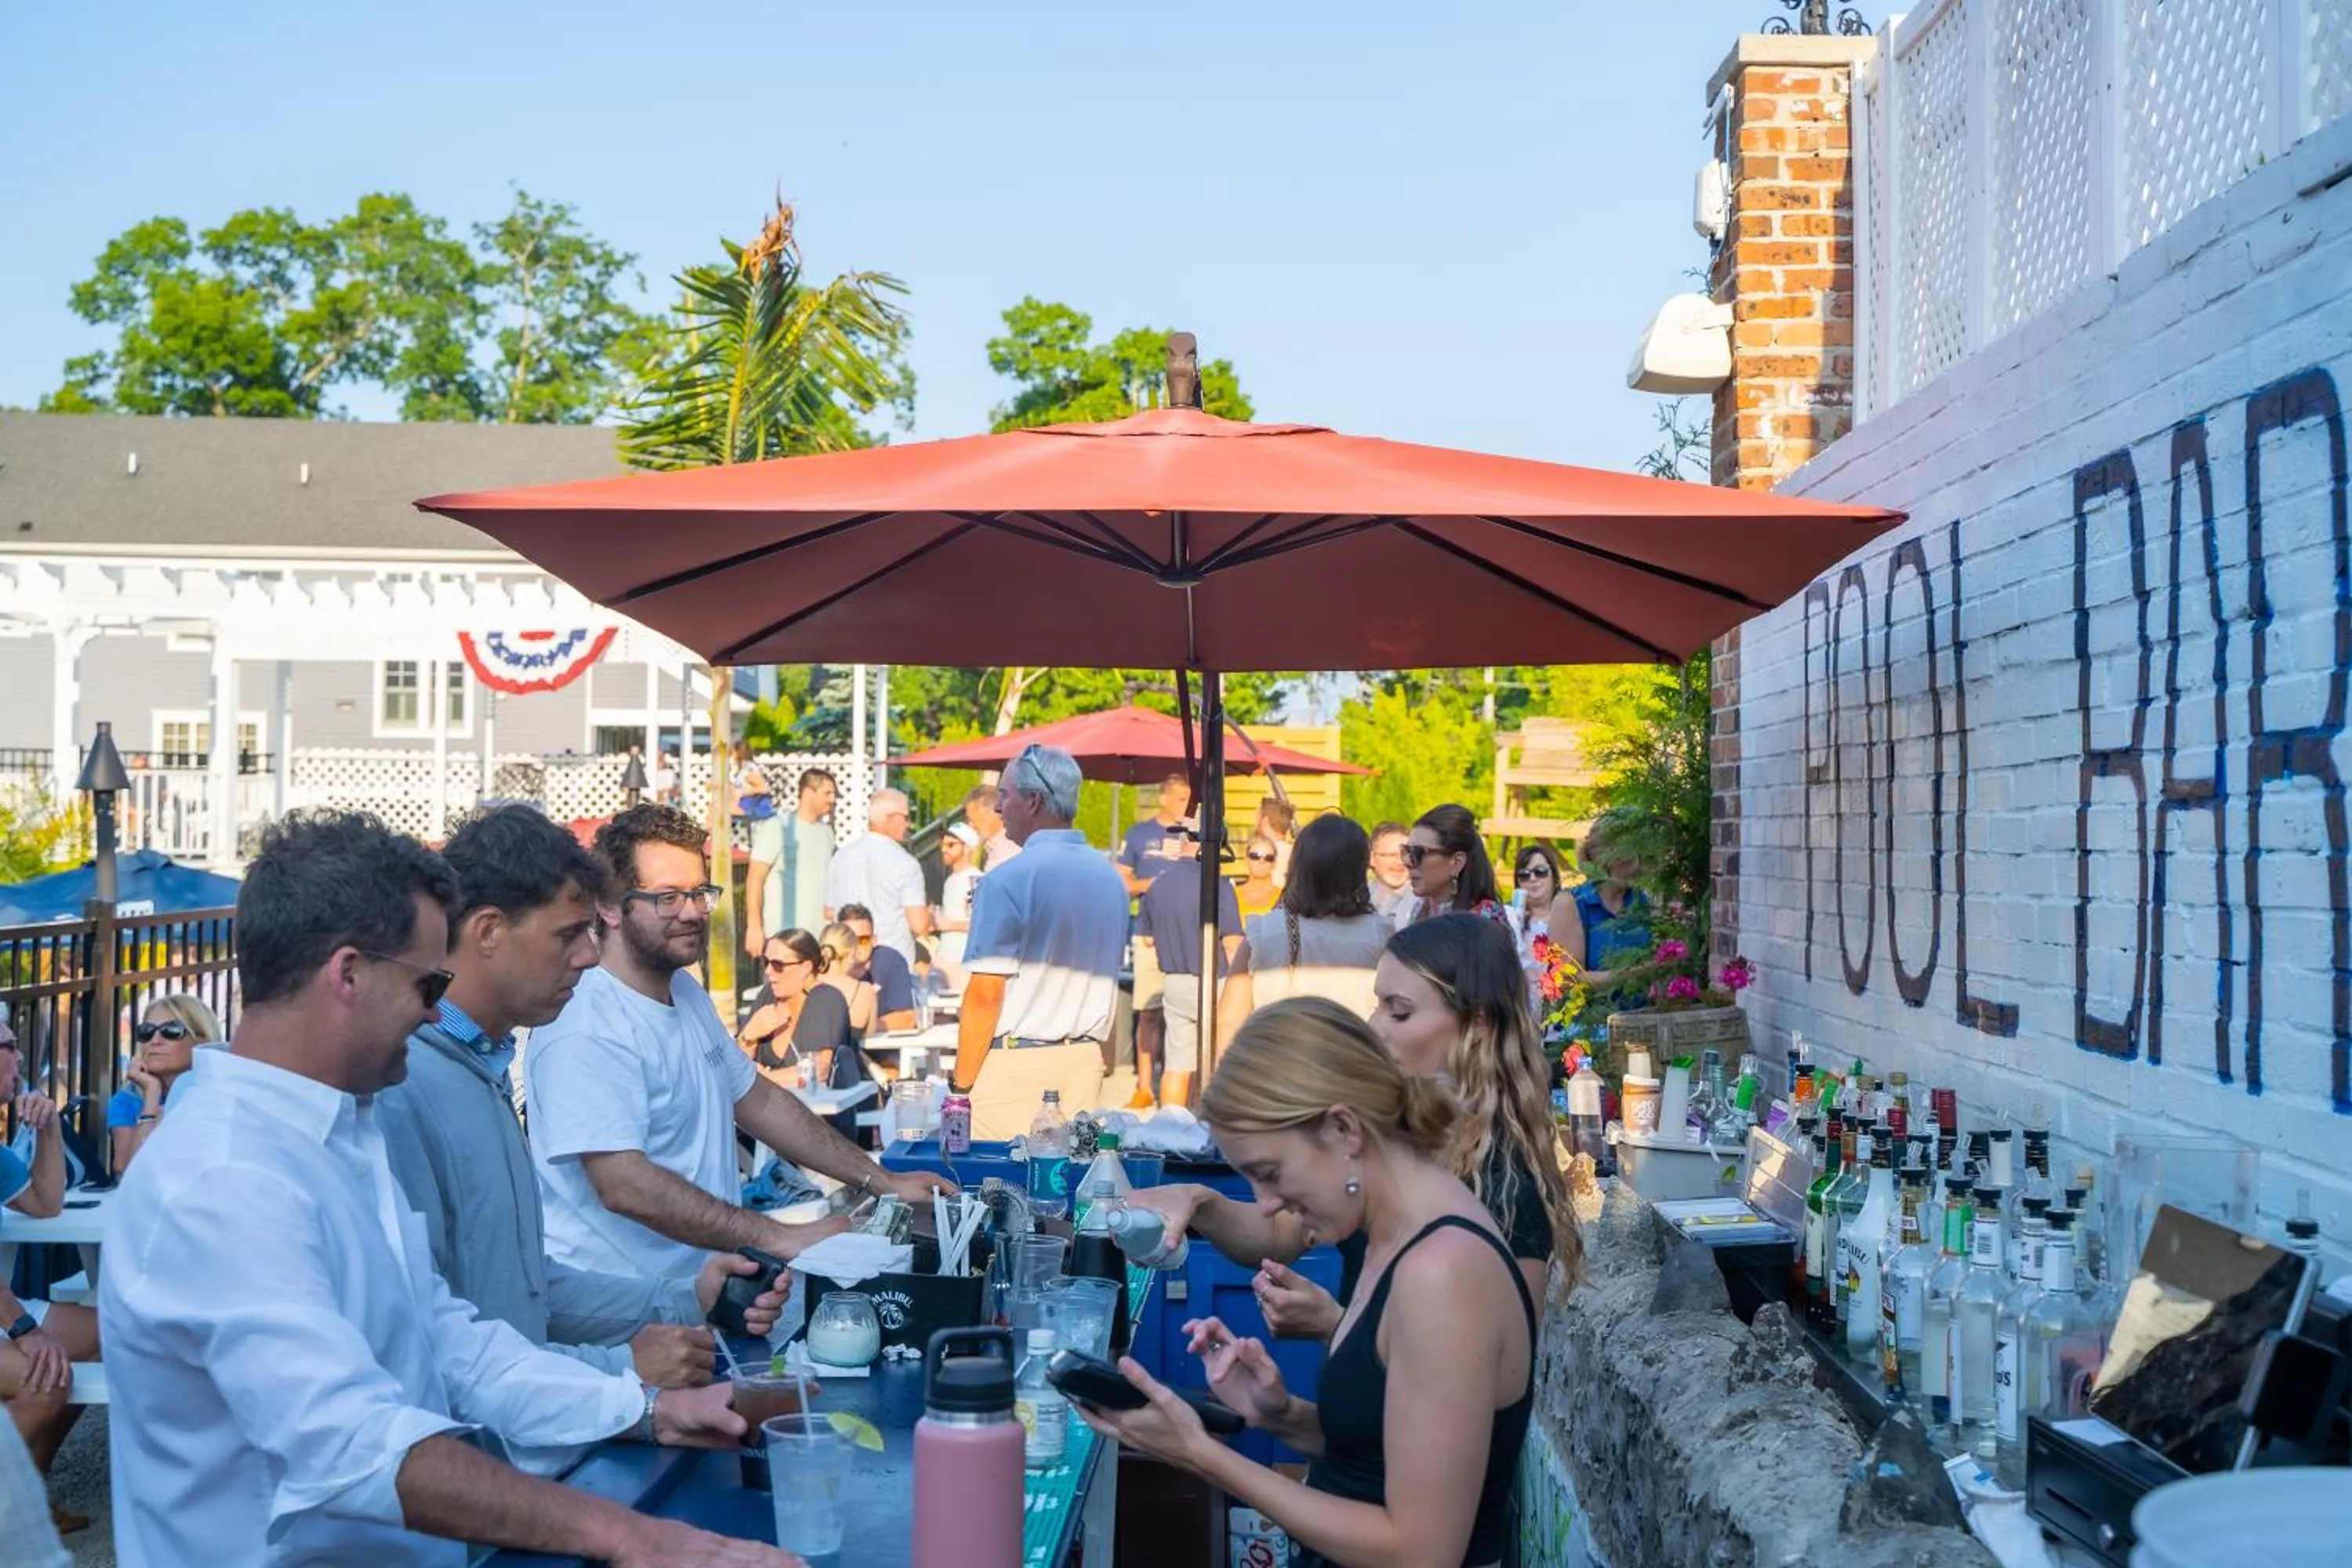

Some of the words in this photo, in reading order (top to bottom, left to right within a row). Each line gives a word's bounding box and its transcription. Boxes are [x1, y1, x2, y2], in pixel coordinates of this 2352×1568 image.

[1804, 518, 2019, 1037] POOL
[2073, 364, 2352, 1117] BAR
[871, 1290, 914, 1308] MALIBU
